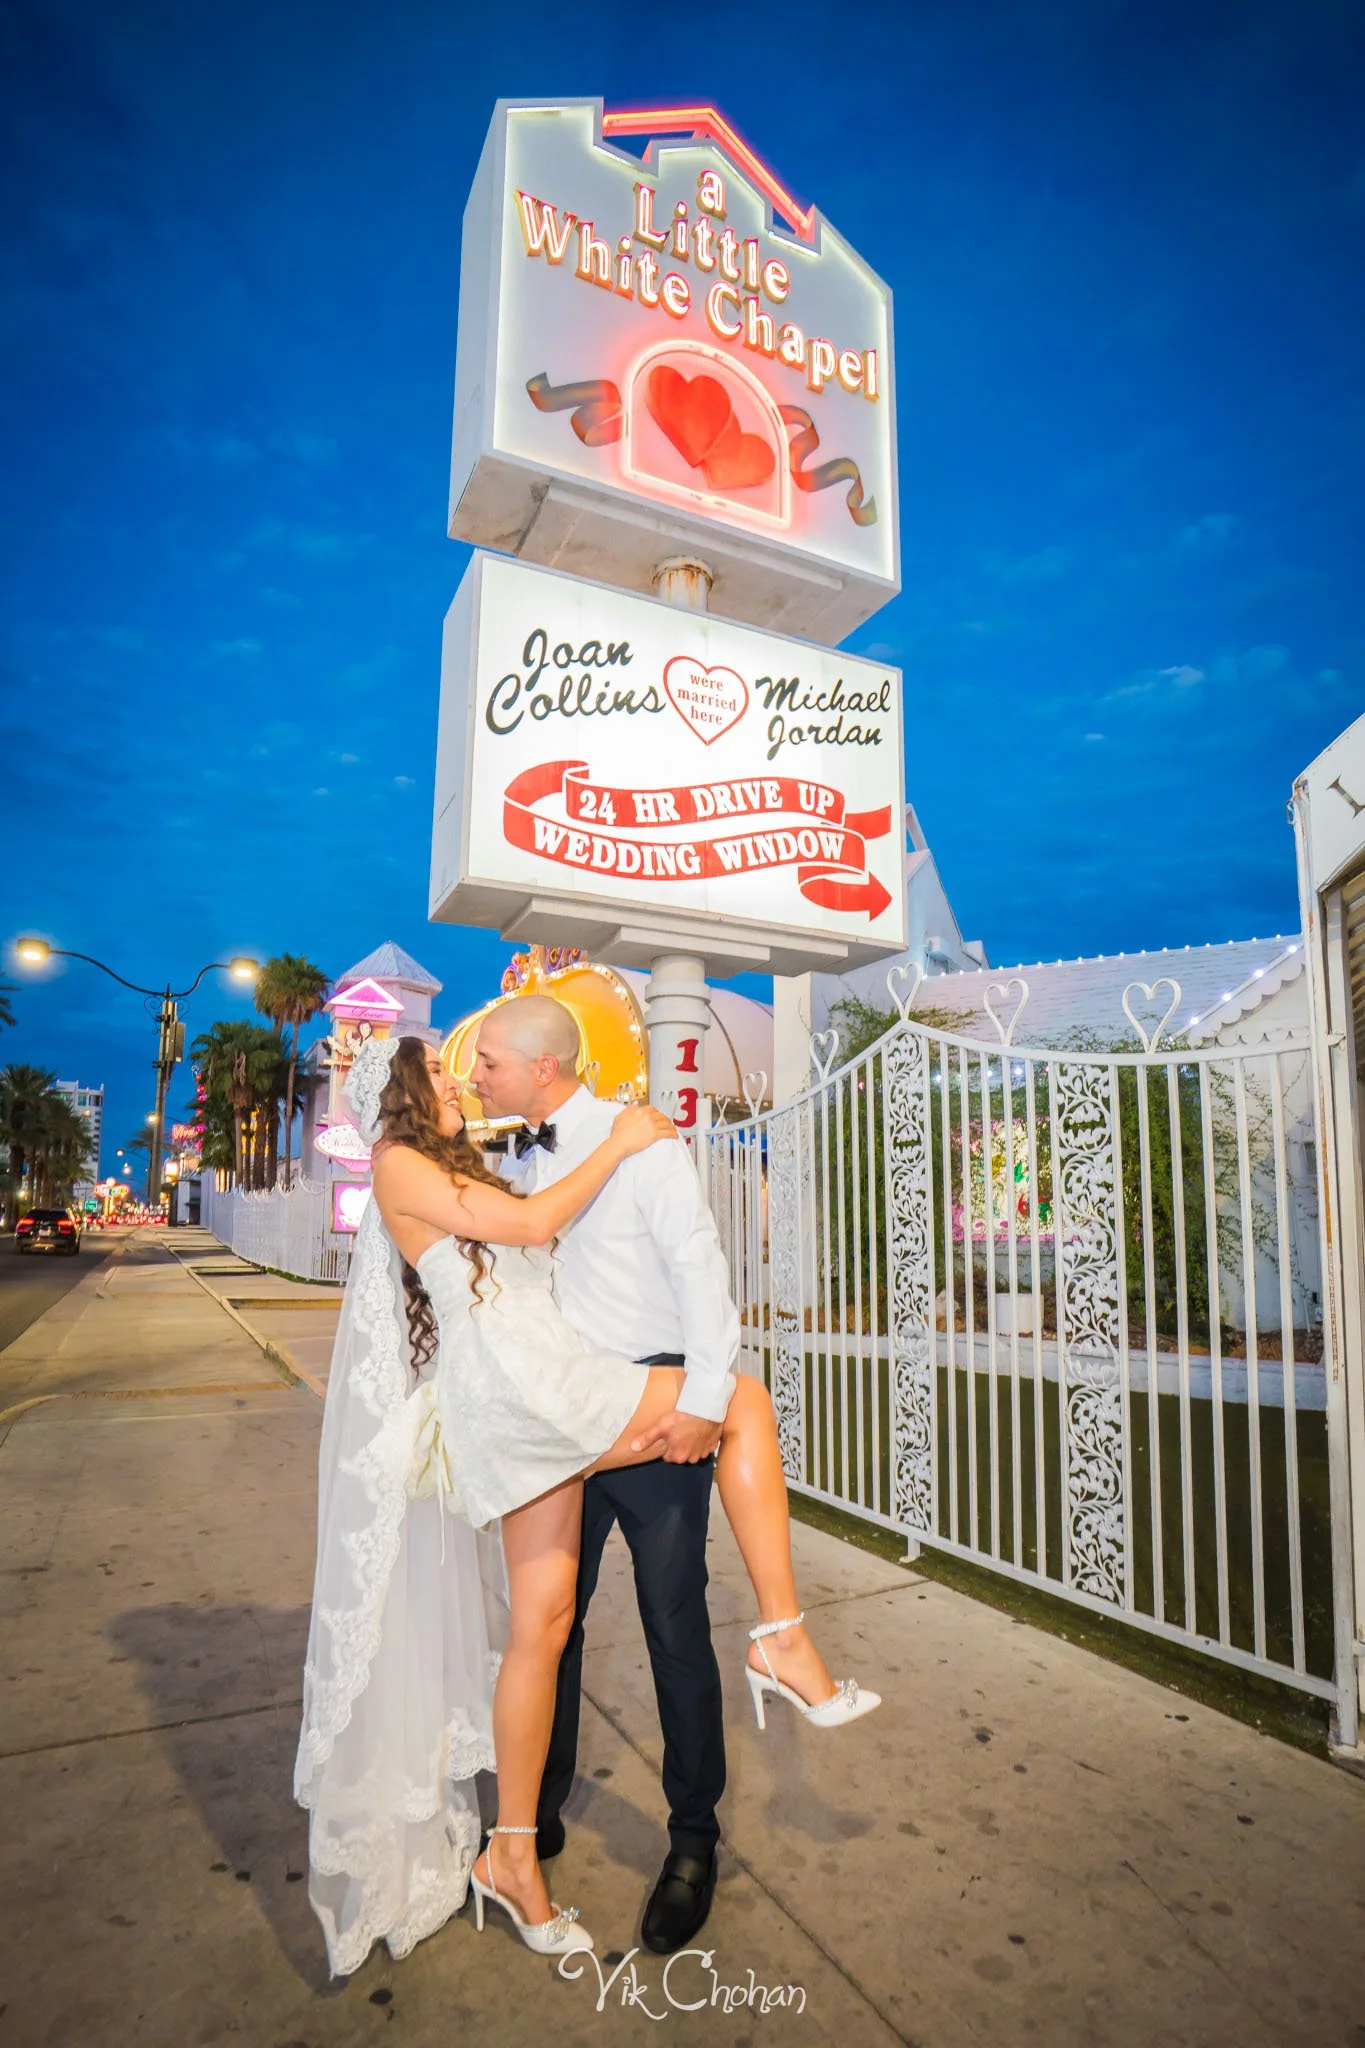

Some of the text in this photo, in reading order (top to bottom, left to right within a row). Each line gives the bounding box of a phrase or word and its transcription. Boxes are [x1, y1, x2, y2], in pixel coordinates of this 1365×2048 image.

[700, 169, 726, 219] a
[632, 182, 791, 304] Little
[514, 190, 879, 403] White Chapel
[523, 628, 634, 692] Joan
[690, 673, 724, 691] were
[485, 673, 667, 735] Collins
[677, 688, 738, 712] married
[690, 705, 724, 725] here
[755, 676, 892, 713] Michael
[767, 714, 883, 761] Jordan
[578, 780, 836, 826] 24 HR DRIVE UP
[532, 817, 846, 877] WEDDING WINDOW
